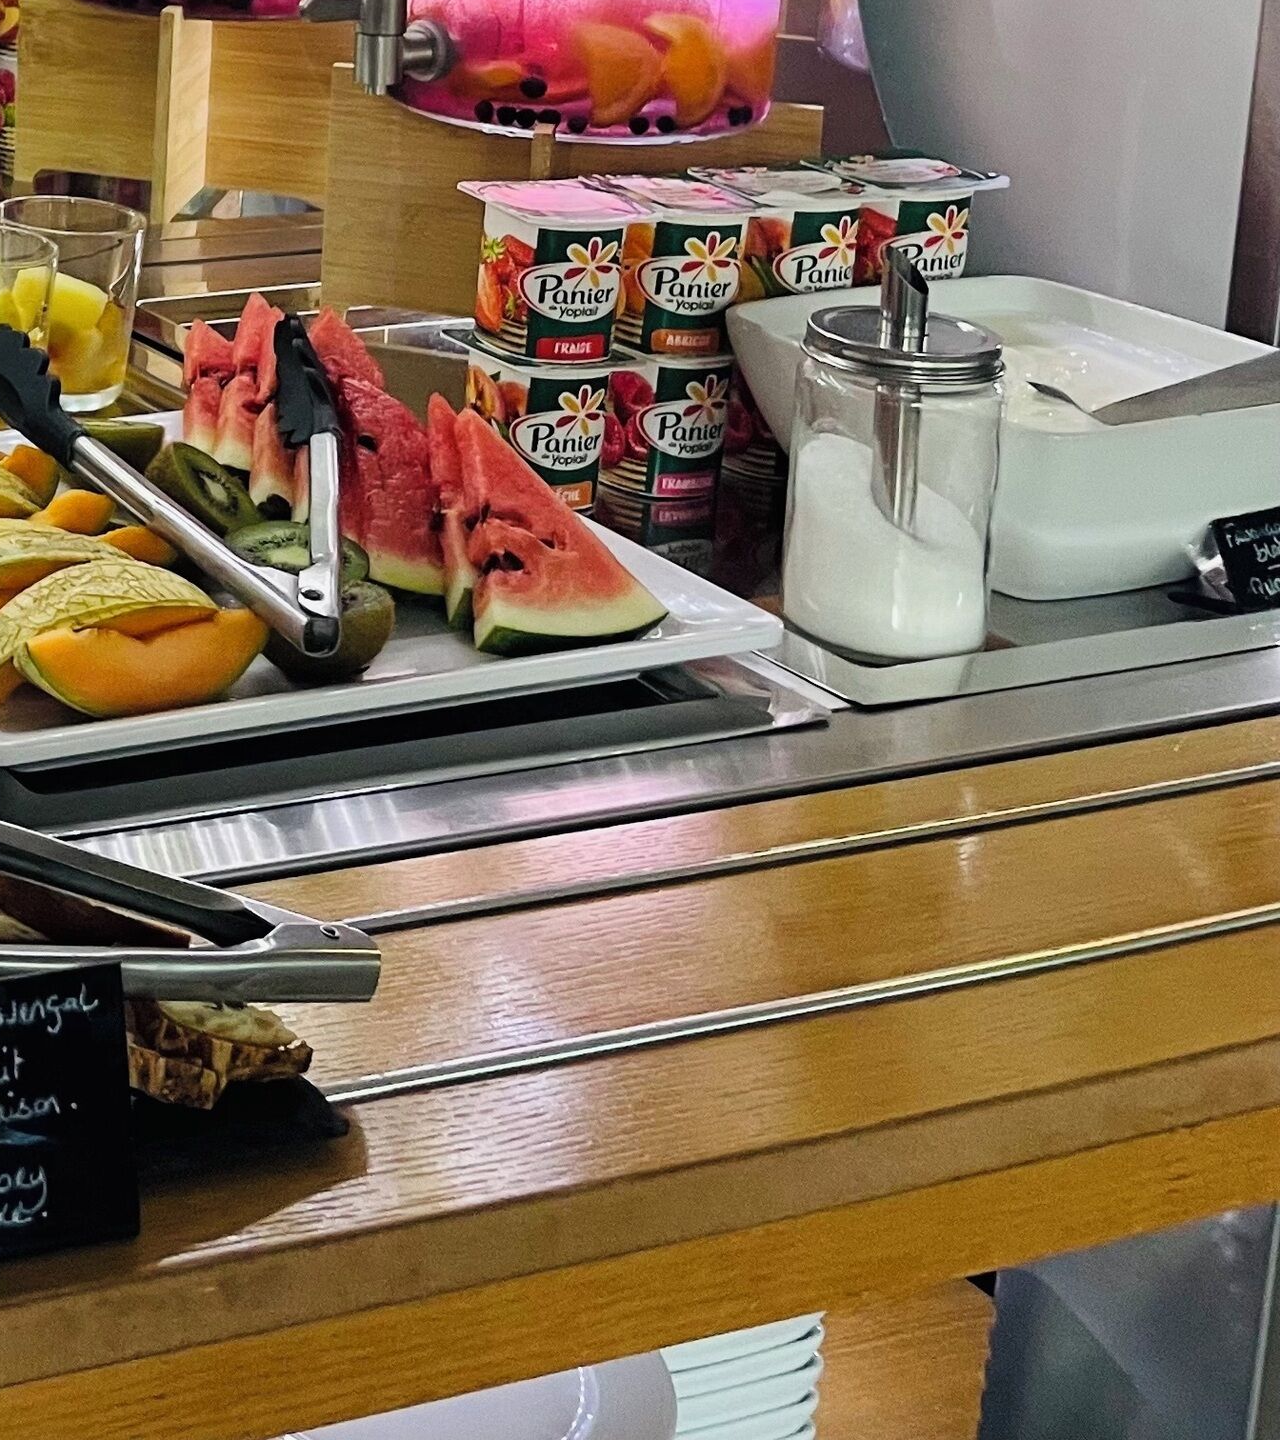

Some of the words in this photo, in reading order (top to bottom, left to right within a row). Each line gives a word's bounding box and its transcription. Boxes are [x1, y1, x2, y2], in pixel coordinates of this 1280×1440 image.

[651, 266, 732, 298] Panier
[791, 254, 853, 285] Panie
[534, 273, 615, 305] Panier
[558, 305, 599, 319] Yoplait
[674, 299, 715, 312] Yoplait
[553, 341, 593, 354] FRAISE
[527, 422, 602, 453] Panier
[654, 411, 724, 442] Panier
